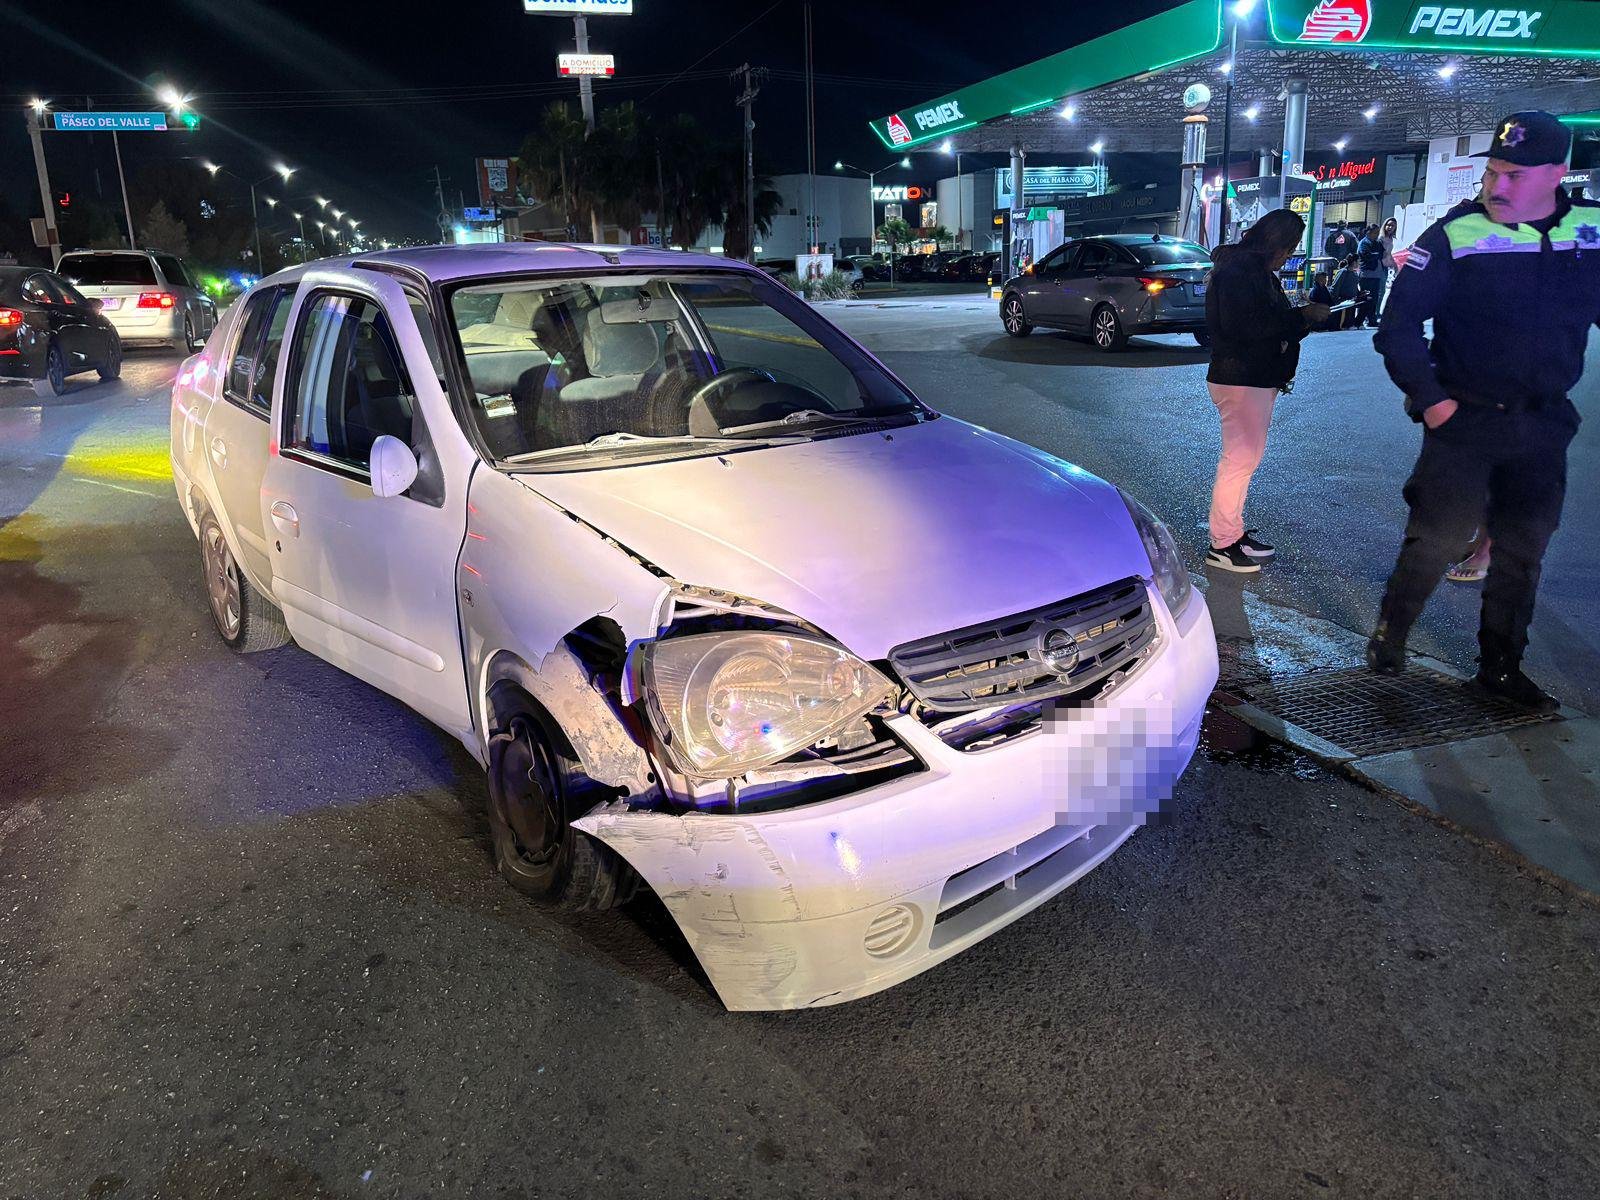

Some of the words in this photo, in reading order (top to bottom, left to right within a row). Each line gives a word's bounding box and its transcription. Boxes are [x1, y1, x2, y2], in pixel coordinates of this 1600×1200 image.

[1409, 6, 1542, 38] PEMEX
[570, 59, 612, 67] DOMICILIO
[914, 100, 964, 131] PEMEX
[62, 117, 96, 127] PASEO
[98, 117, 118, 127] DEL
[120, 117, 151, 127] VALLE
[1338, 158, 1376, 180] Miguel
[1051, 176, 1080, 184] HABANO
[1560, 174, 1591, 184] PEMEX
[1237, 182, 1260, 192] PEMEX
